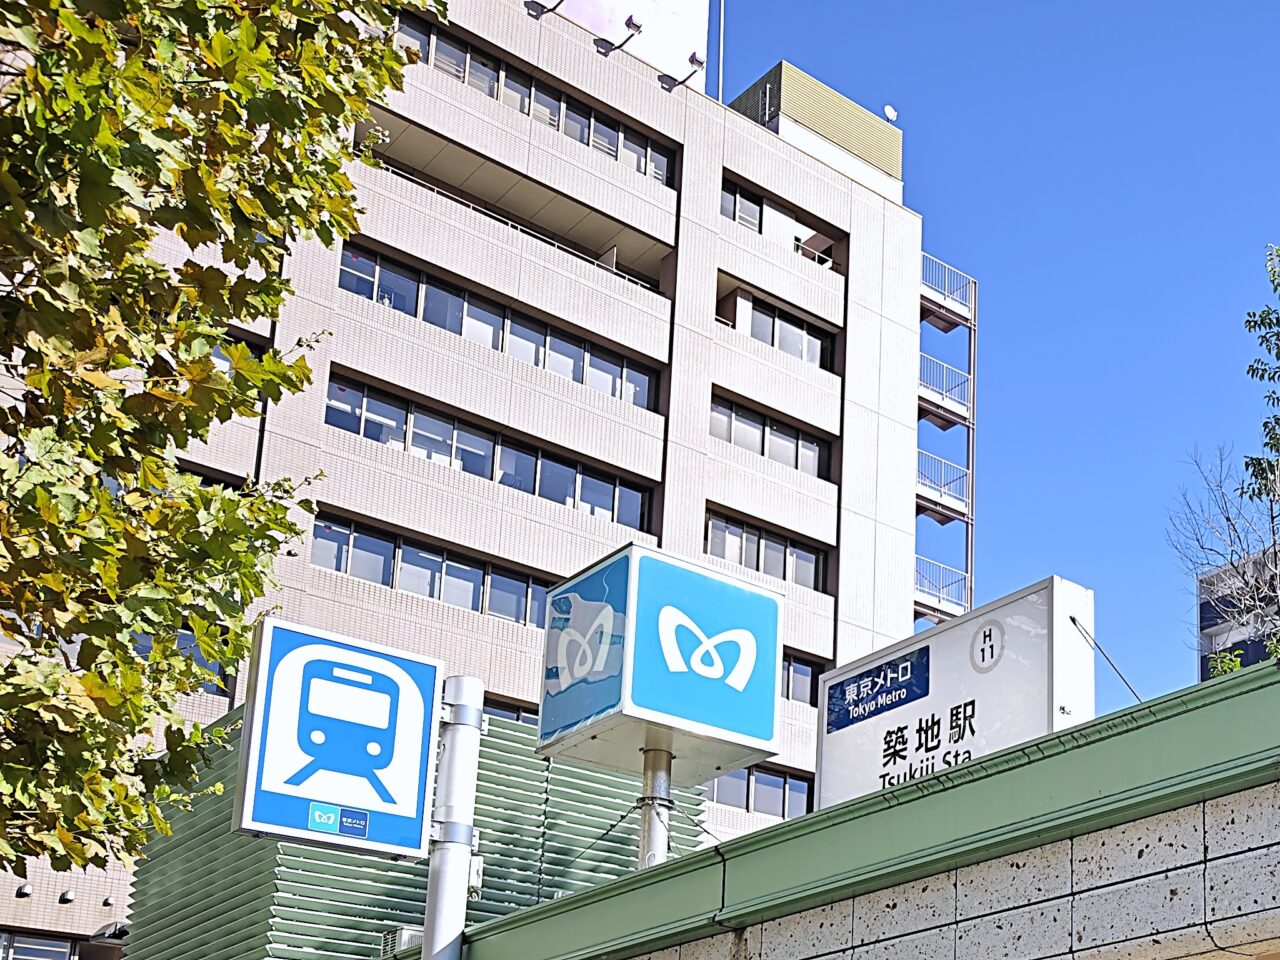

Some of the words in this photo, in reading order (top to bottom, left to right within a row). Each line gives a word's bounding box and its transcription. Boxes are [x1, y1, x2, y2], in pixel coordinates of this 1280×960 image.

[983, 628, 992, 644] H
[980, 644, 995, 663] 11
[845, 661, 911, 704] 東京メトロ
[848, 701, 876, 719] Tokyo
[878, 688, 907, 708] Metro
[882, 699, 976, 768] 築地駅
